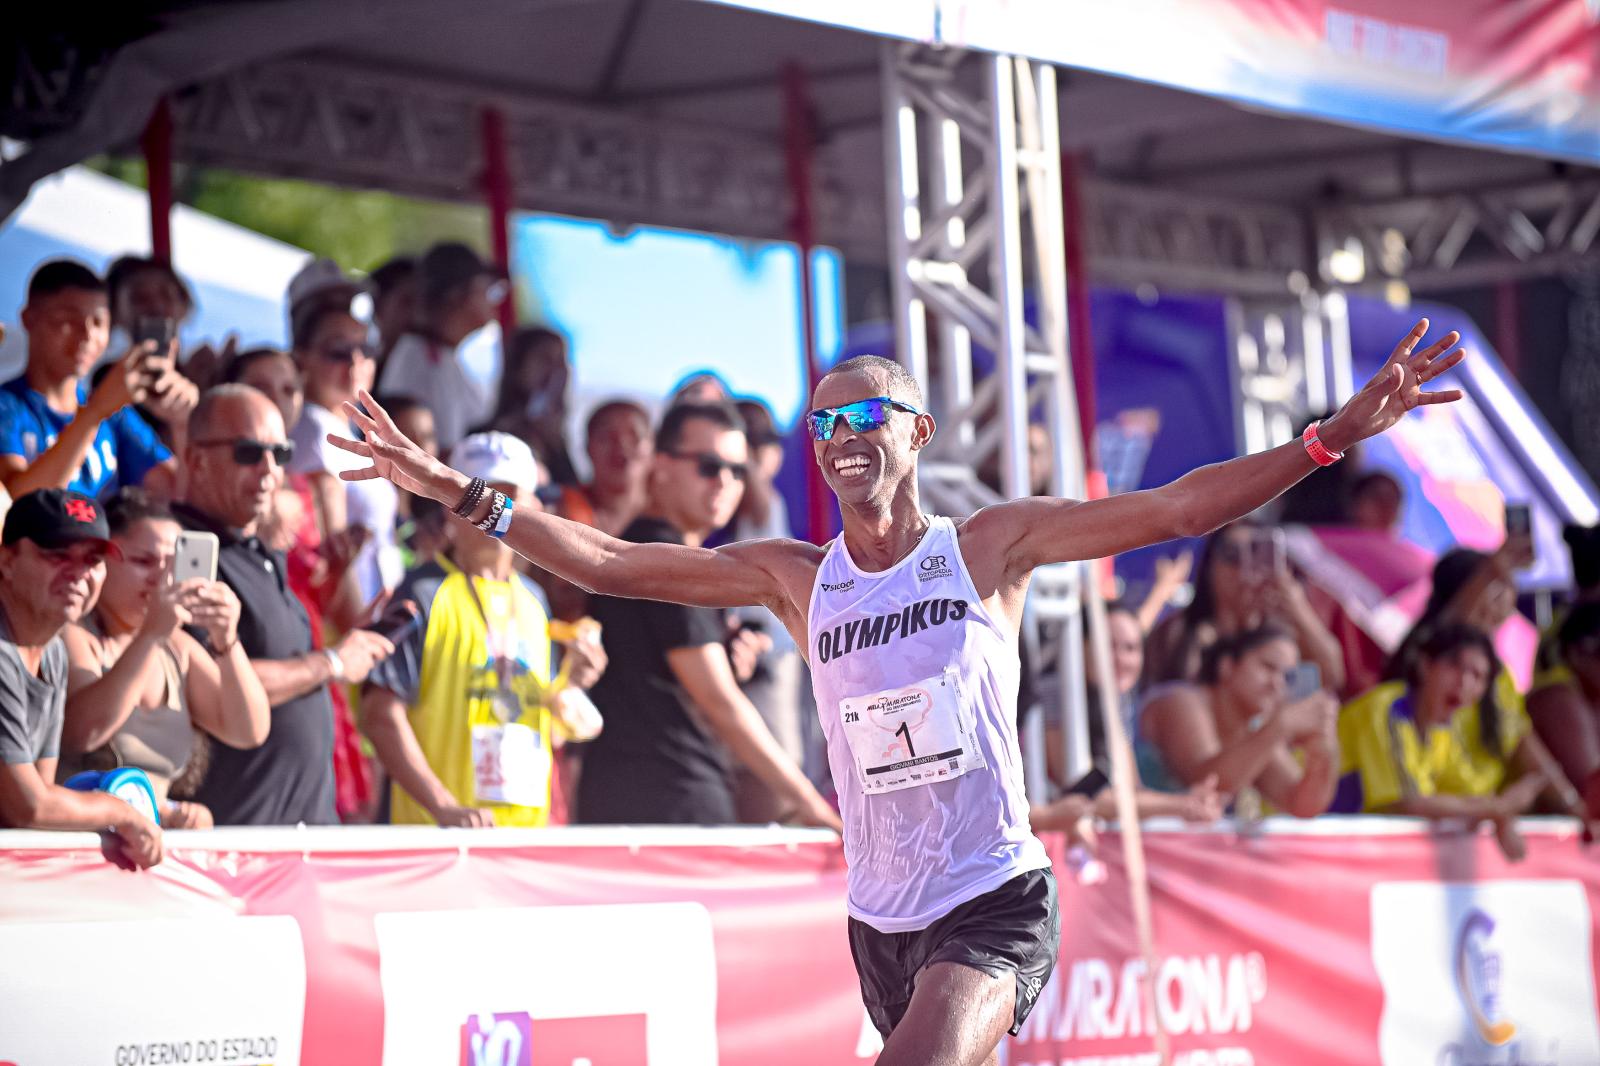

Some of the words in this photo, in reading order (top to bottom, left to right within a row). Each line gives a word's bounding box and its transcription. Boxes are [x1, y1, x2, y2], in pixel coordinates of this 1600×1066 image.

[830, 579, 854, 592] SICOOB
[818, 599, 968, 664] OLYMPIKUS
[895, 722, 916, 758] 1
[915, 755, 939, 766] SANTOS
[115, 1041, 192, 1066] GOVERNO
[197, 1040, 217, 1062] DO
[223, 1036, 277, 1060] ESTADO
